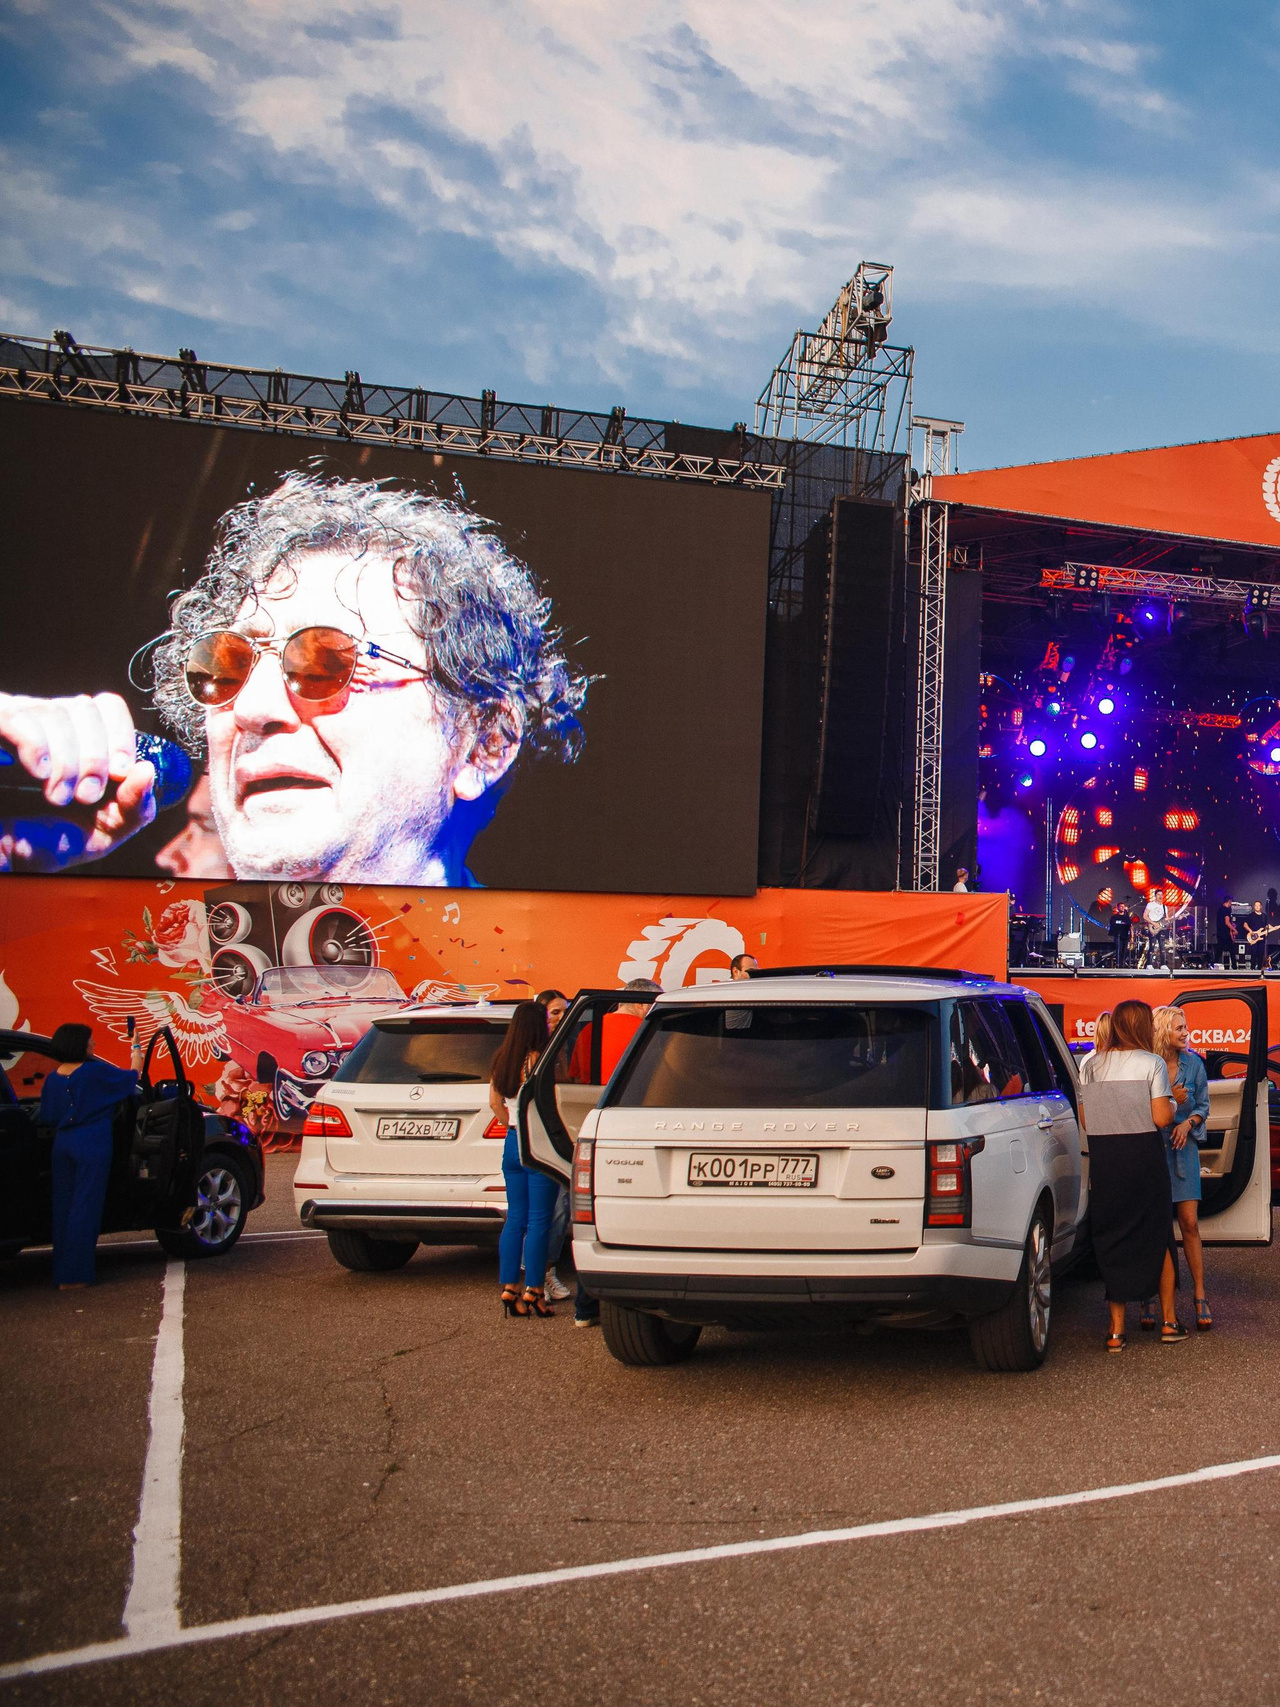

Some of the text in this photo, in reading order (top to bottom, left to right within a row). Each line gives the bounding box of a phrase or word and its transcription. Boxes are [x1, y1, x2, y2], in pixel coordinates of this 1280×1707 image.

[654, 1121, 861, 1132] RANGE ROVER
[780, 1158, 811, 1174] 777
